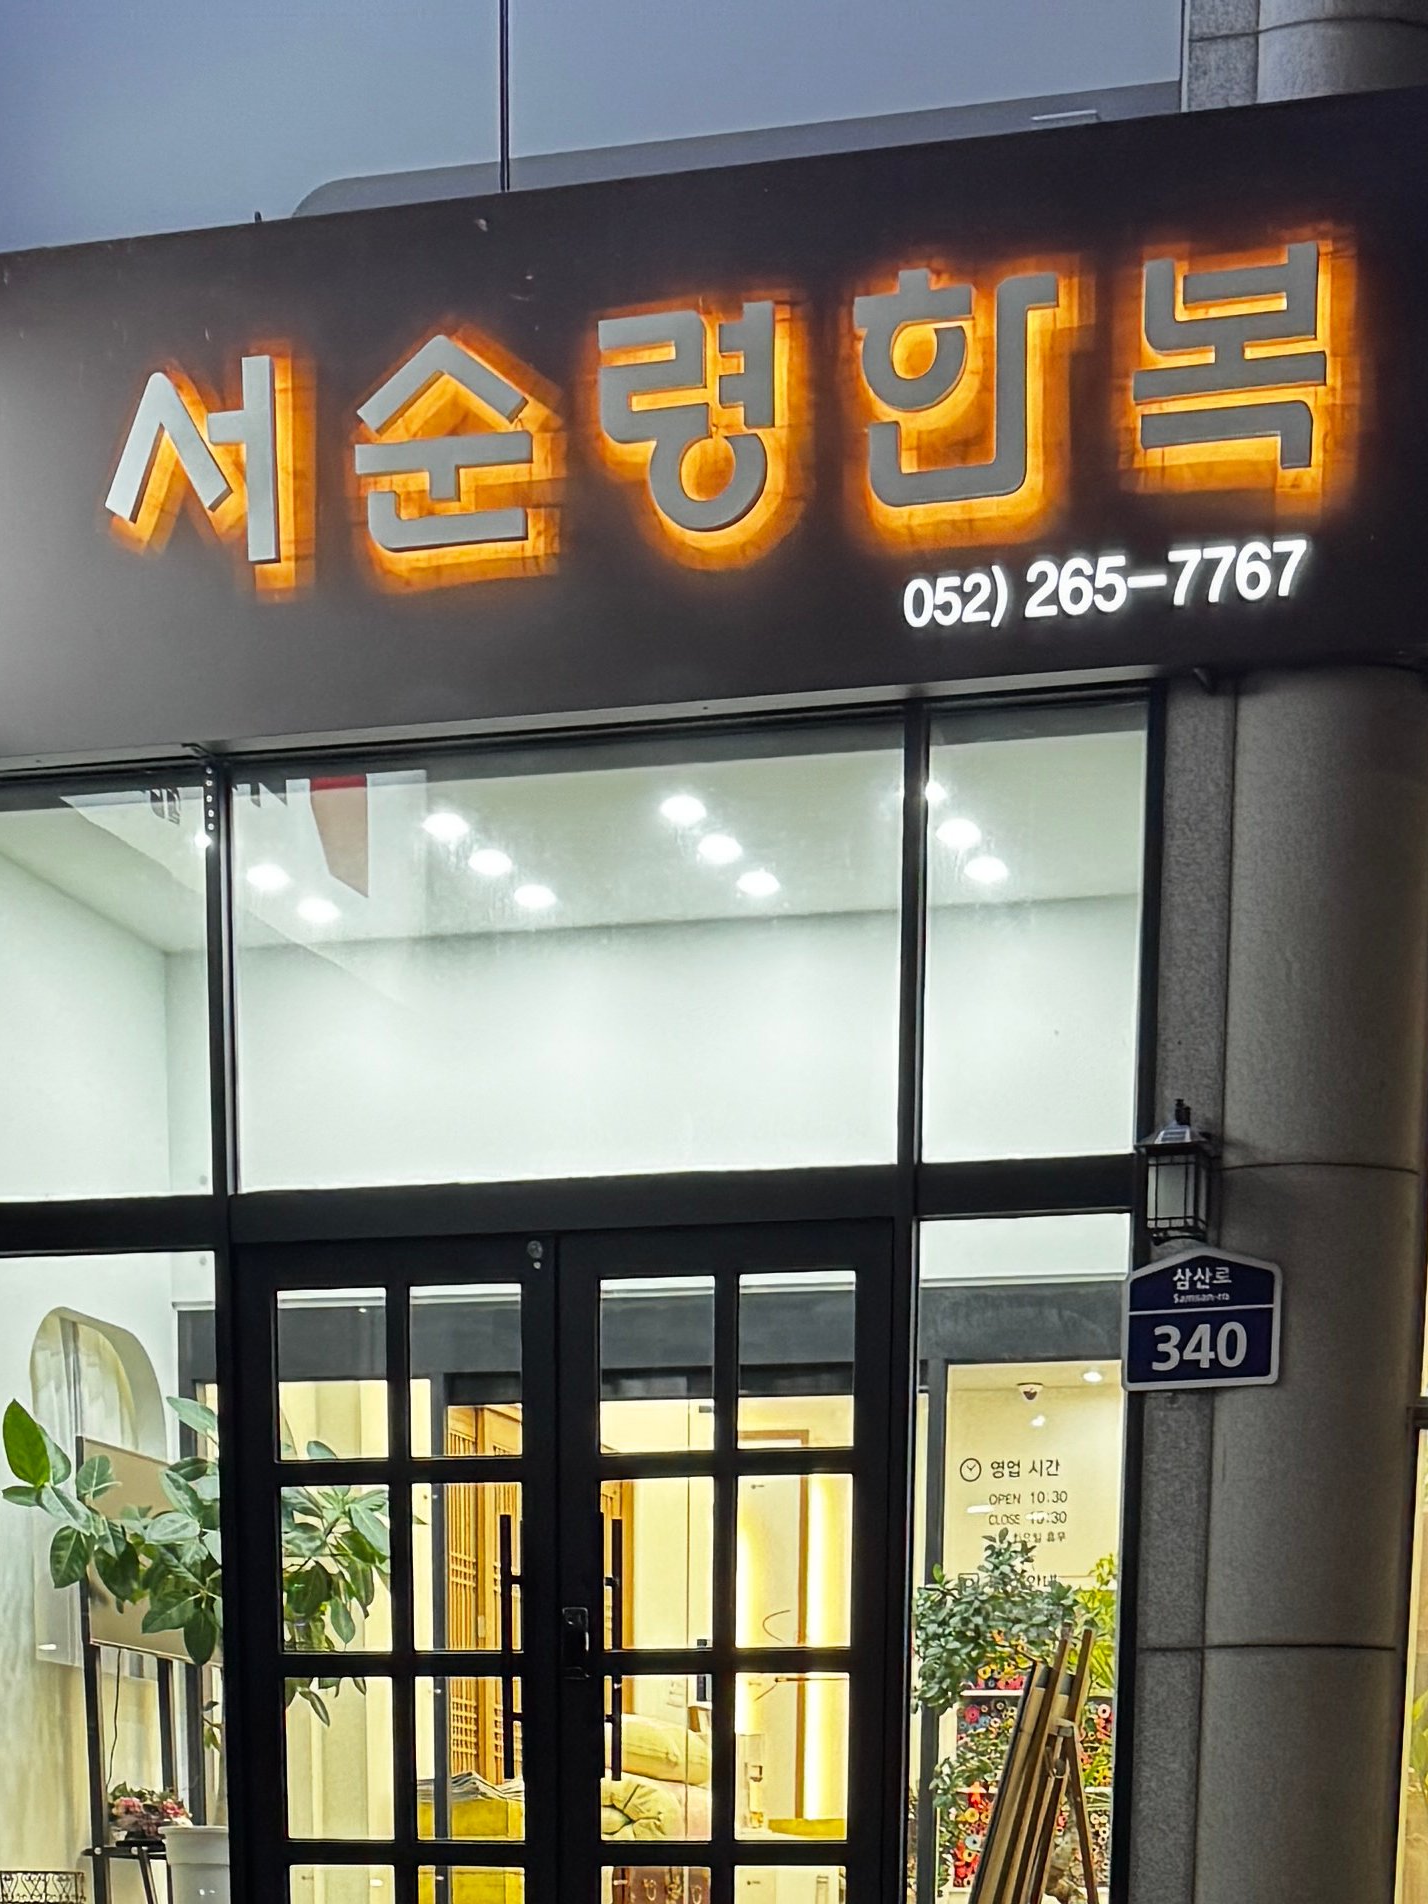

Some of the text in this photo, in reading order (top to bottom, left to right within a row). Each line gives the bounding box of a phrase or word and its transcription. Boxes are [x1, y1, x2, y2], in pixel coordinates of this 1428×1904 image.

[102, 240, 1329, 567] 서순령한복
[903, 538, 1308, 629] 052) 265-7767
[1172, 1266, 1232, 1290] 삼산로
[1151, 1321, 1248, 1371] 340
[990, 1459, 1060, 1479] 영업 시간
[988, 1490, 1068, 1505] OPEN 10:30
[988, 1514, 1021, 1526] CLOSE
